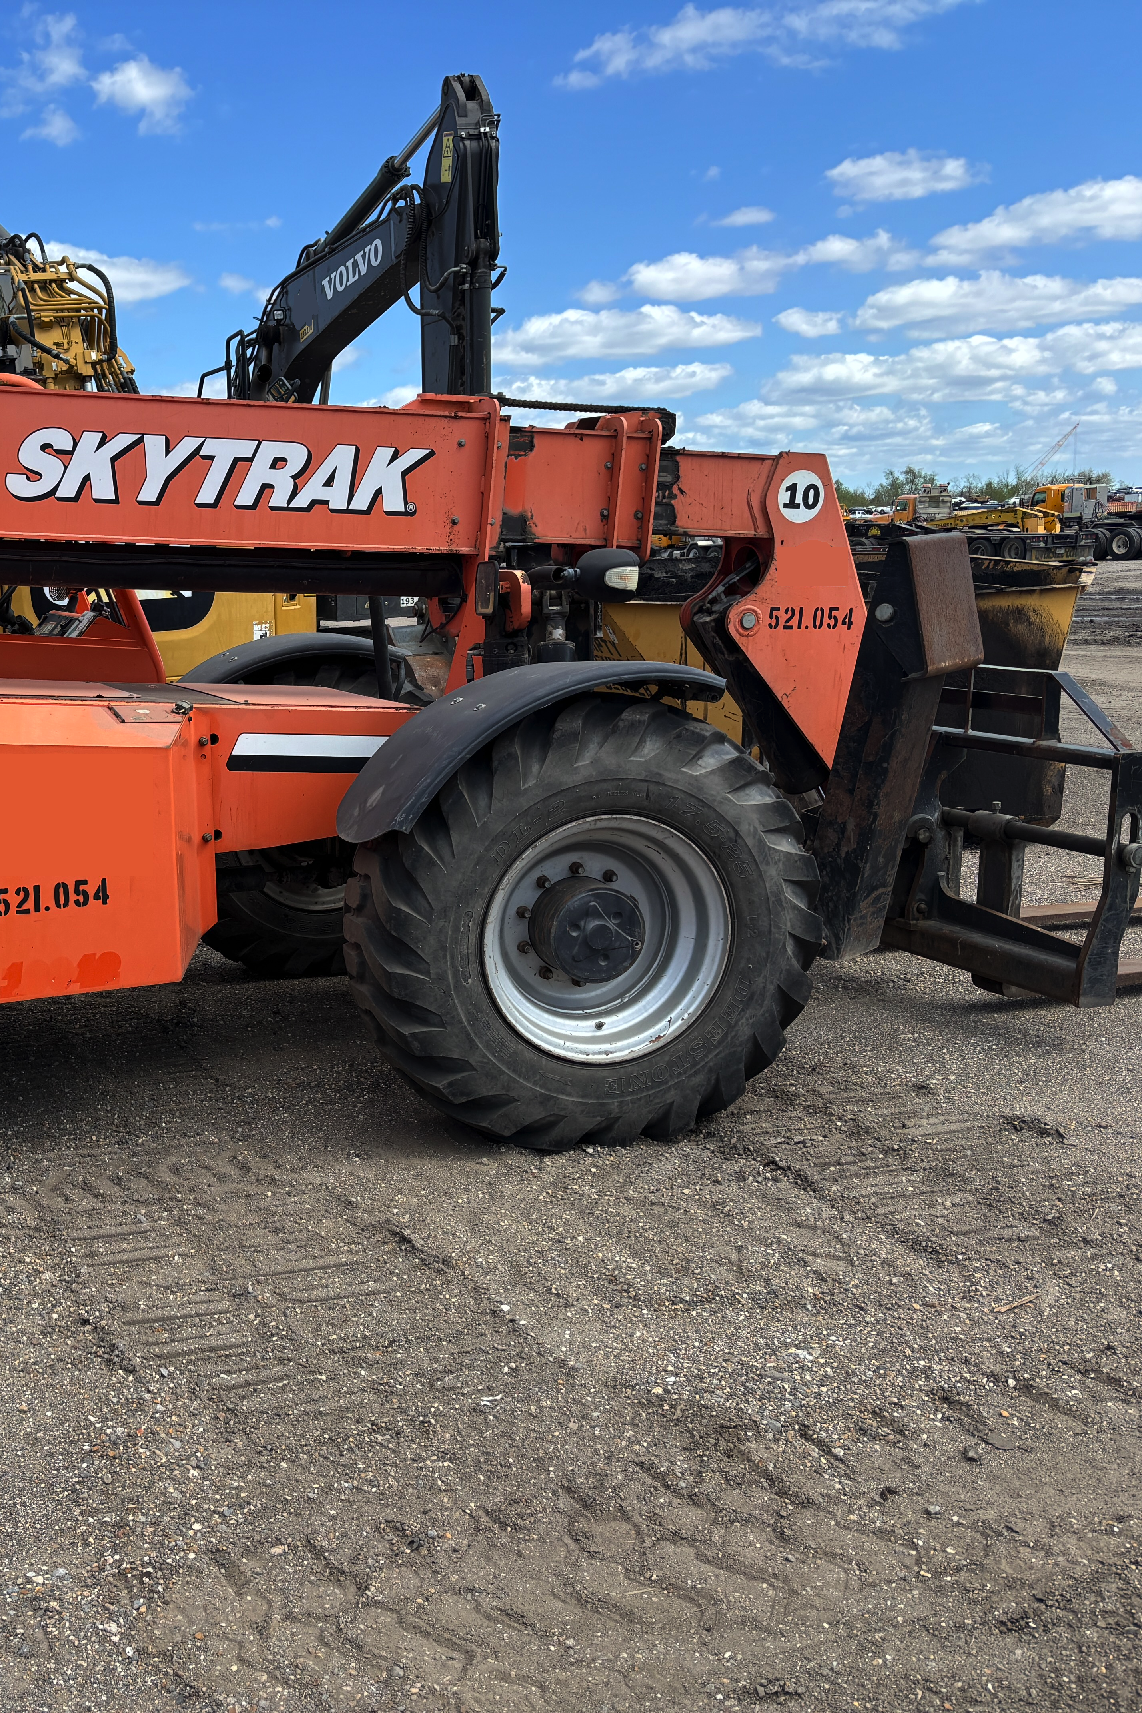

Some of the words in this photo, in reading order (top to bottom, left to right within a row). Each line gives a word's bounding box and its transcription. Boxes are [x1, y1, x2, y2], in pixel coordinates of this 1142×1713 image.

[321, 238, 383, 301] VOLVO
[5, 426, 436, 517] SKYTRAK
[782, 482, 821, 510] 10
[767, 605, 855, 632] 521.054
[604, 975, 754, 1096] DEESTONE
